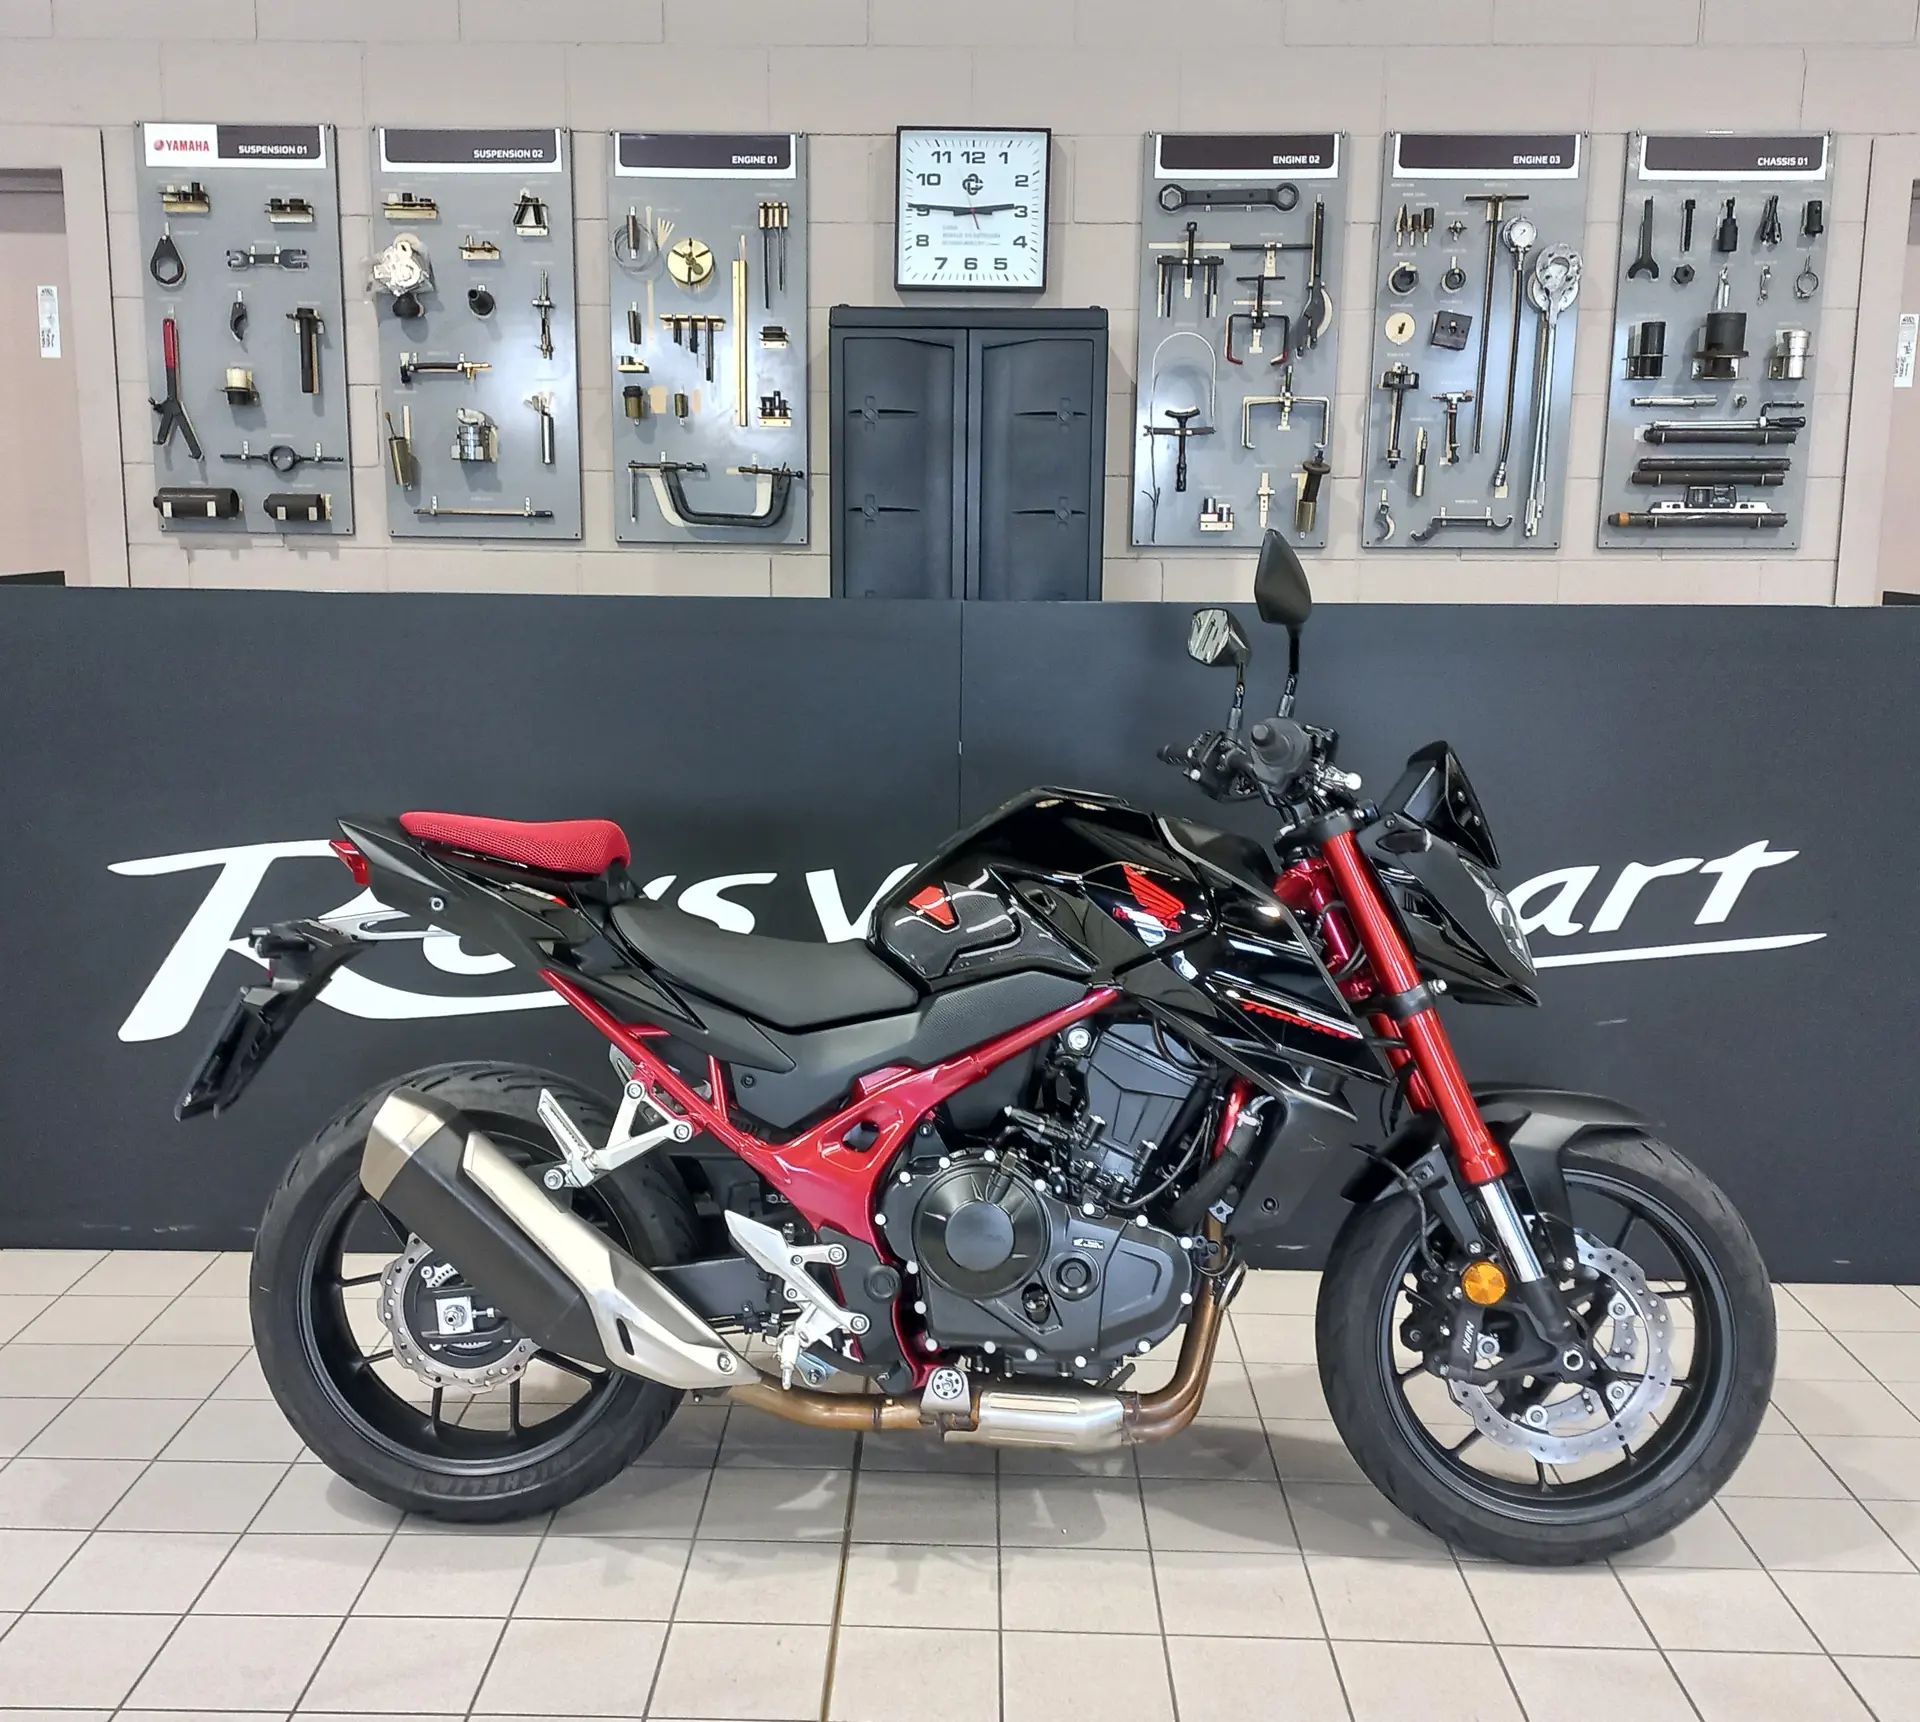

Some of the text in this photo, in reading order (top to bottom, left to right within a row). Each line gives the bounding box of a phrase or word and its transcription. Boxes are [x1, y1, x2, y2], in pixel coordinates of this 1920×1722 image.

[165, 140, 210, 152] YAMAHA
[238, 144, 308, 155] SUSPENSION 01
[473, 148, 543, 159] SUSPENSION 02
[731, 155, 778, 164] ENGINE 01
[931, 151, 951, 164] 11
[961, 151, 986, 164] 12
[999, 152, 1009, 164] 1
[1272, 155, 1320, 164] ENGINE 02
[1513, 155, 1561, 164] ENGINE 03
[1757, 157, 1808, 166] CHASSIS 01
[916, 173, 941, 186] 10
[1014, 174, 1029, 187] 2
[916, 204, 930, 217] 9
[1014, 205, 1028, 218] 3
[916, 234, 929, 247] 8
[1013, 235, 1028, 248] 4
[934, 257, 948, 270] 7
[964, 258, 978, 270] 6
[994, 258, 1008, 270] 5
